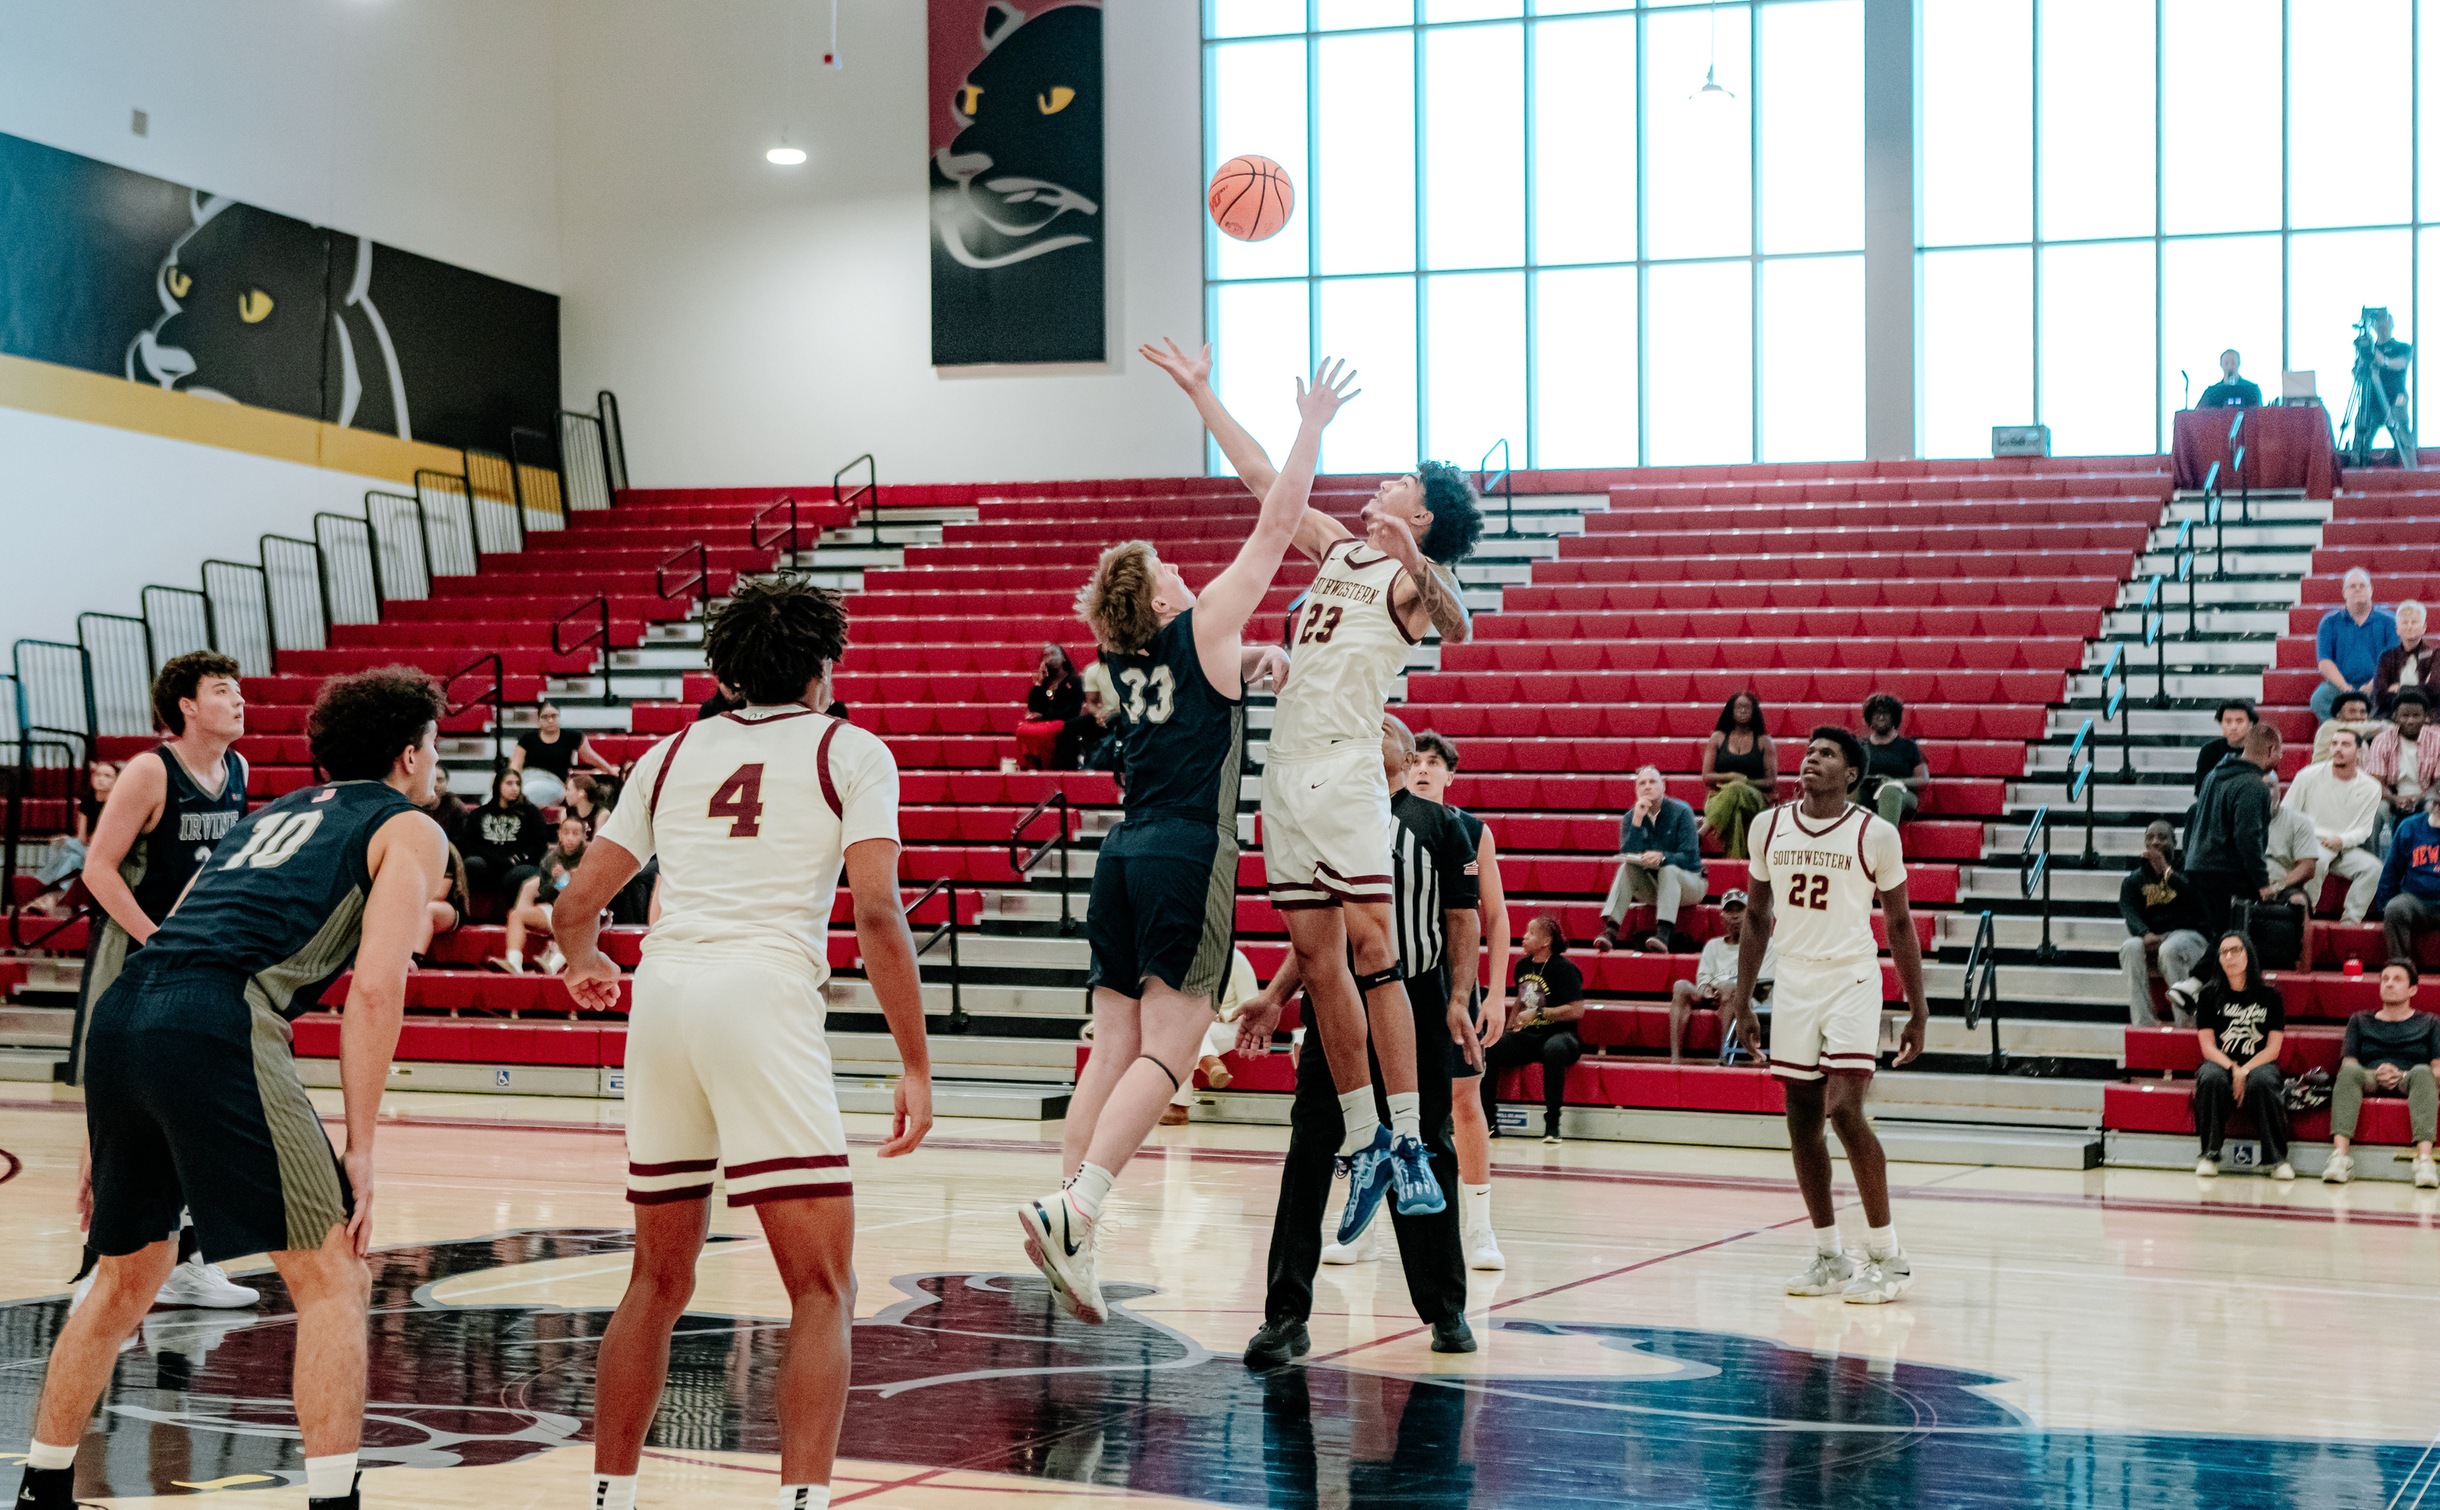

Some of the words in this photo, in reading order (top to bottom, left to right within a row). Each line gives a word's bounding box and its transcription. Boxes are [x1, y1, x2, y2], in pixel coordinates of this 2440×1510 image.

[1299, 602, 1343, 645] 23
[1119, 664, 1176, 725] 33
[706, 761, 766, 840] 4
[217, 809, 324, 871] 10
[1773, 850, 1853, 871] SOUTHWESTERN
[1788, 873, 1829, 910] 22
